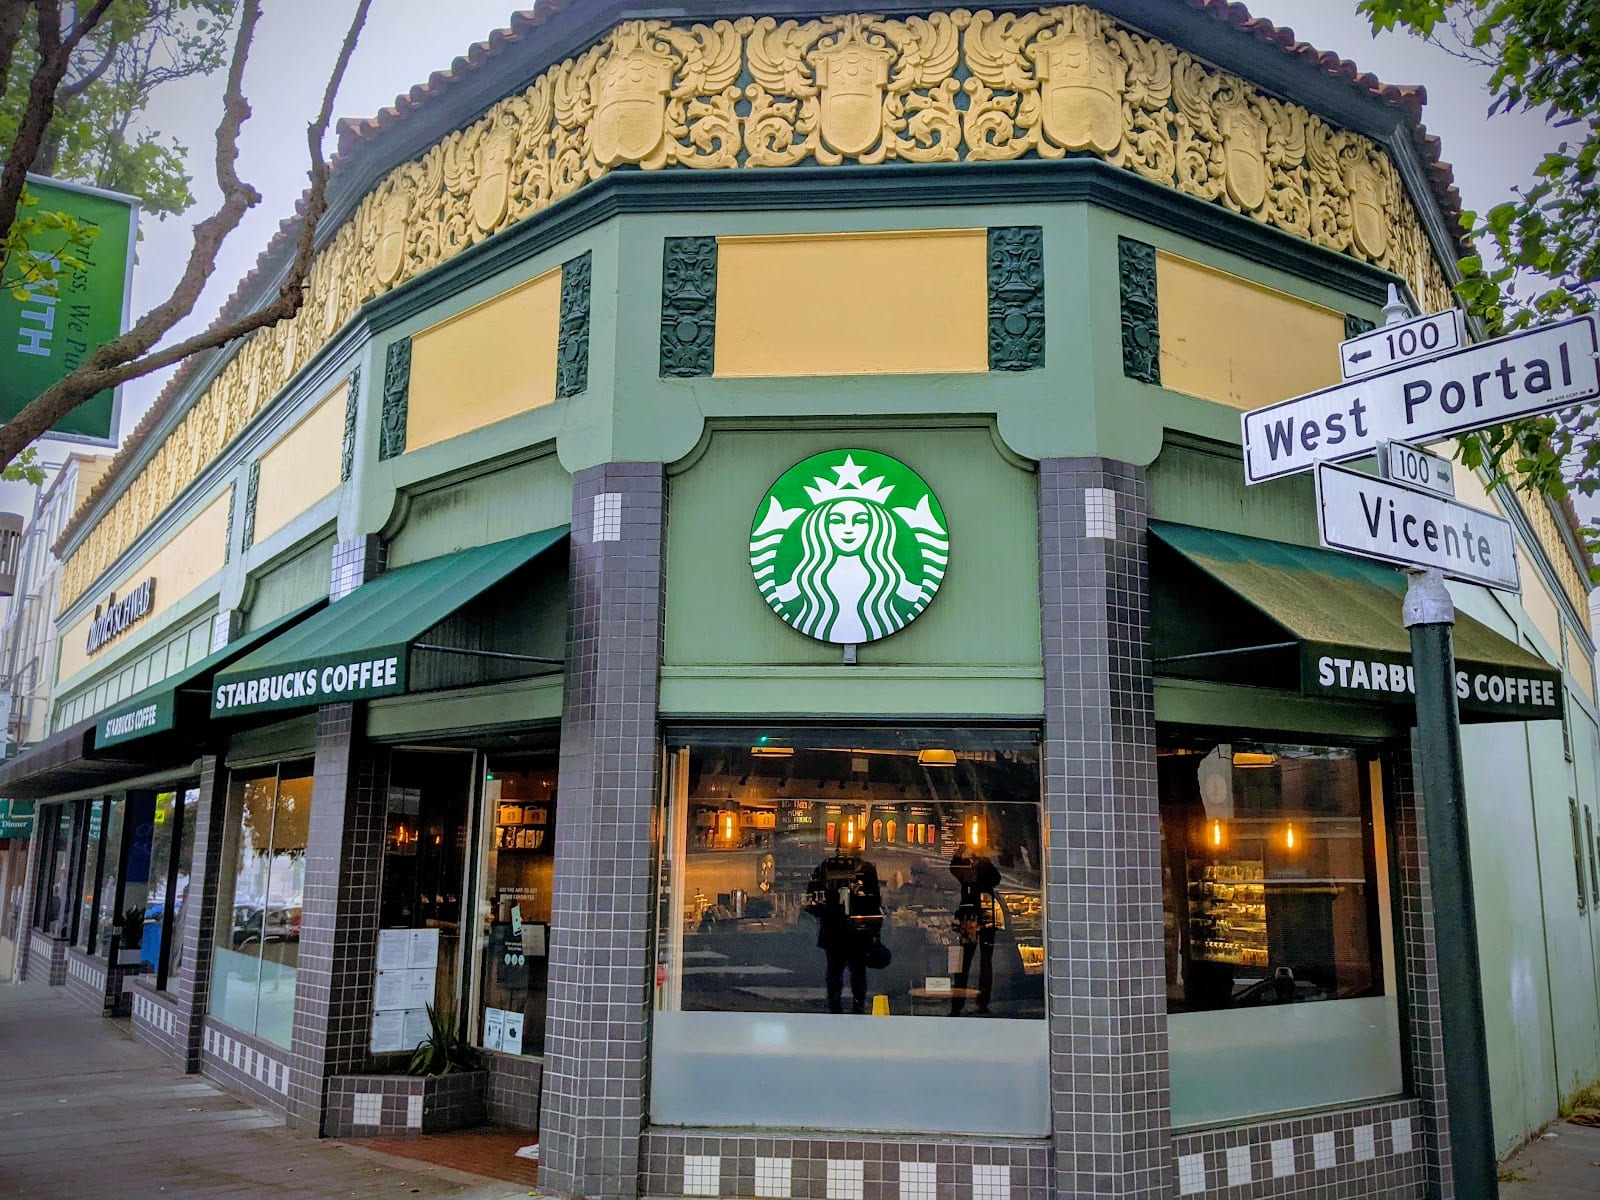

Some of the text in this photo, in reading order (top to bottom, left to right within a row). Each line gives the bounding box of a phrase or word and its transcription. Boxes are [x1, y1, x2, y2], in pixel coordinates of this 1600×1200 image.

[68, 305, 91, 333] We
[1386, 322, 1440, 360] 100
[1264, 342, 1572, 461] West Portal
[1399, 451, 1430, 484] 100
[1359, 491, 1491, 567] Vicente
[215, 656, 398, 710] STARBUCKS COFFEE
[1318, 656, 1556, 706] STARBS COFFEE
[105, 704, 157, 739] STARBUCKS COFFEE
[2, 820, 28, 828] Dinner
